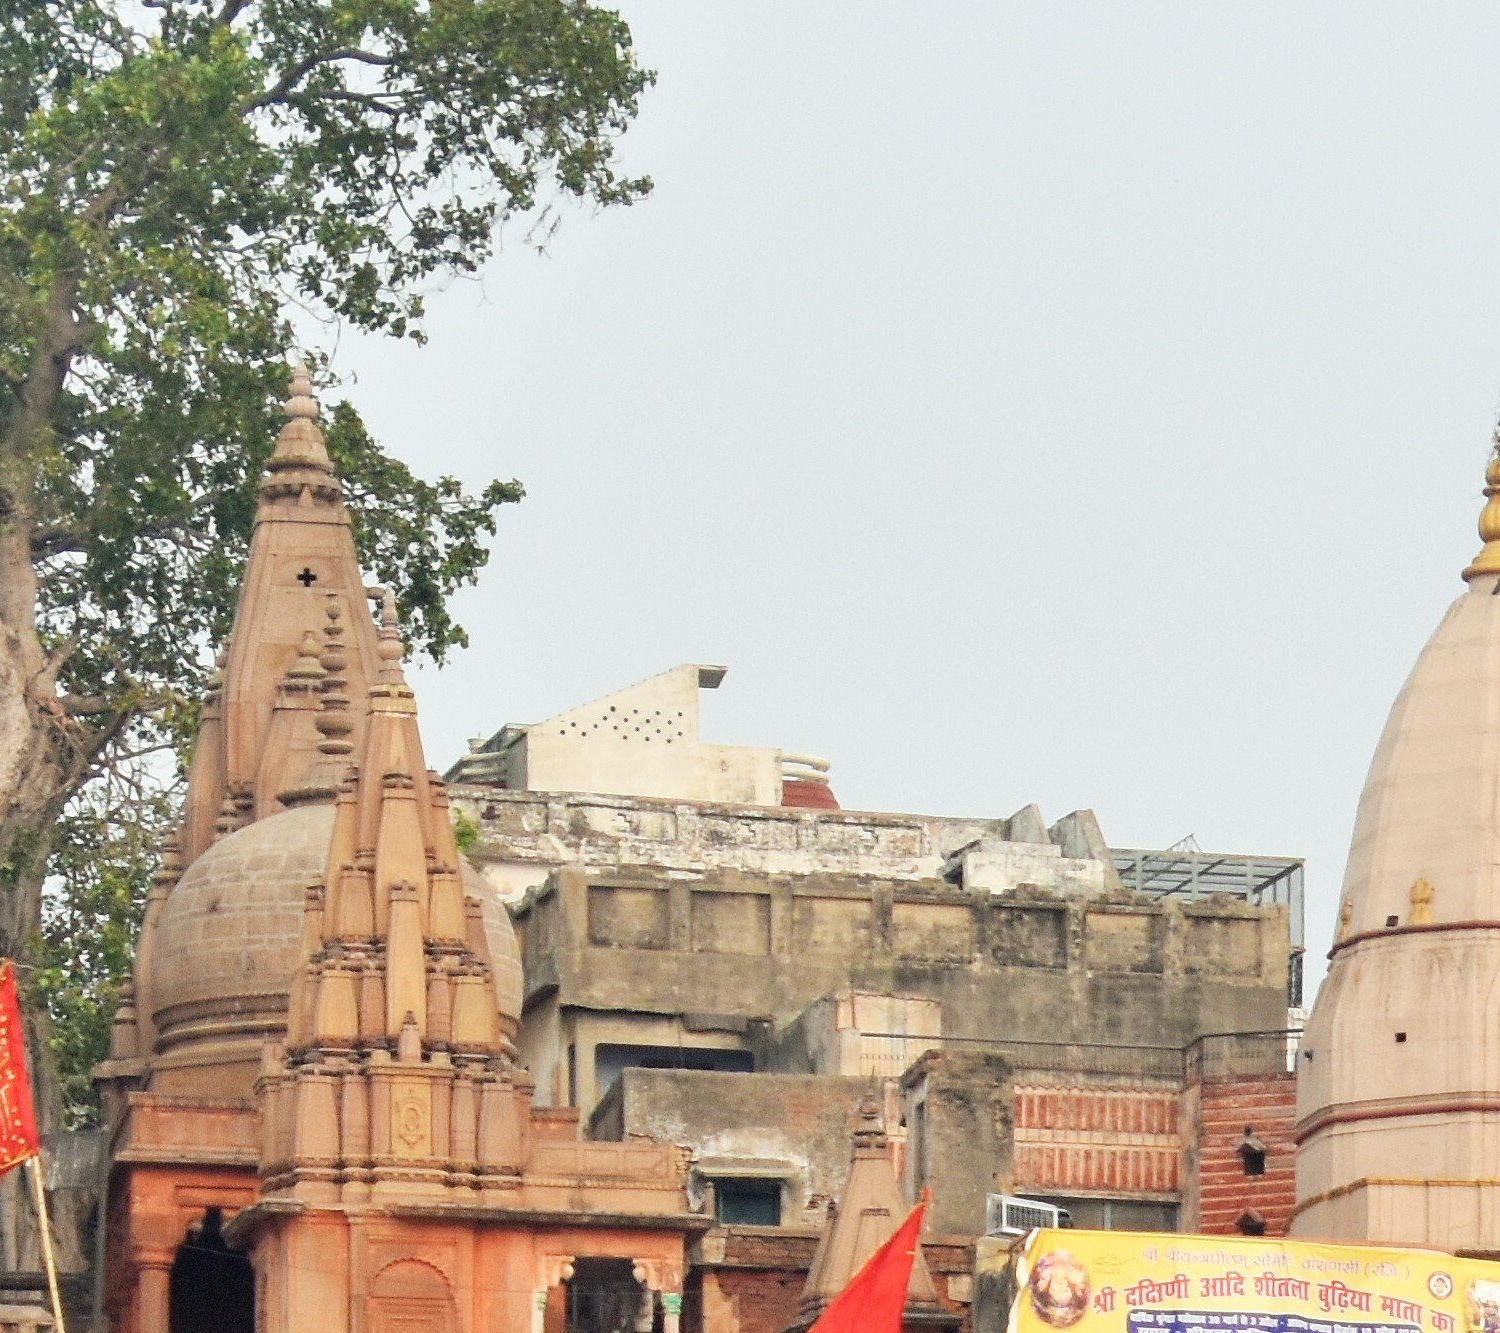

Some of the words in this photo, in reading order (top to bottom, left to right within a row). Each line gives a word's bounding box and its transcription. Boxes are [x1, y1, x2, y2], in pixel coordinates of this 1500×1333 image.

[1094, 1286, 1116, 1313] श्री
[1125, 1273, 1190, 1306] दक्षिणी
[1200, 1271, 1245, 1297] आदि
[1254, 1271, 1310, 1300] शीतला
[1379, 1295, 1424, 1324] माता
